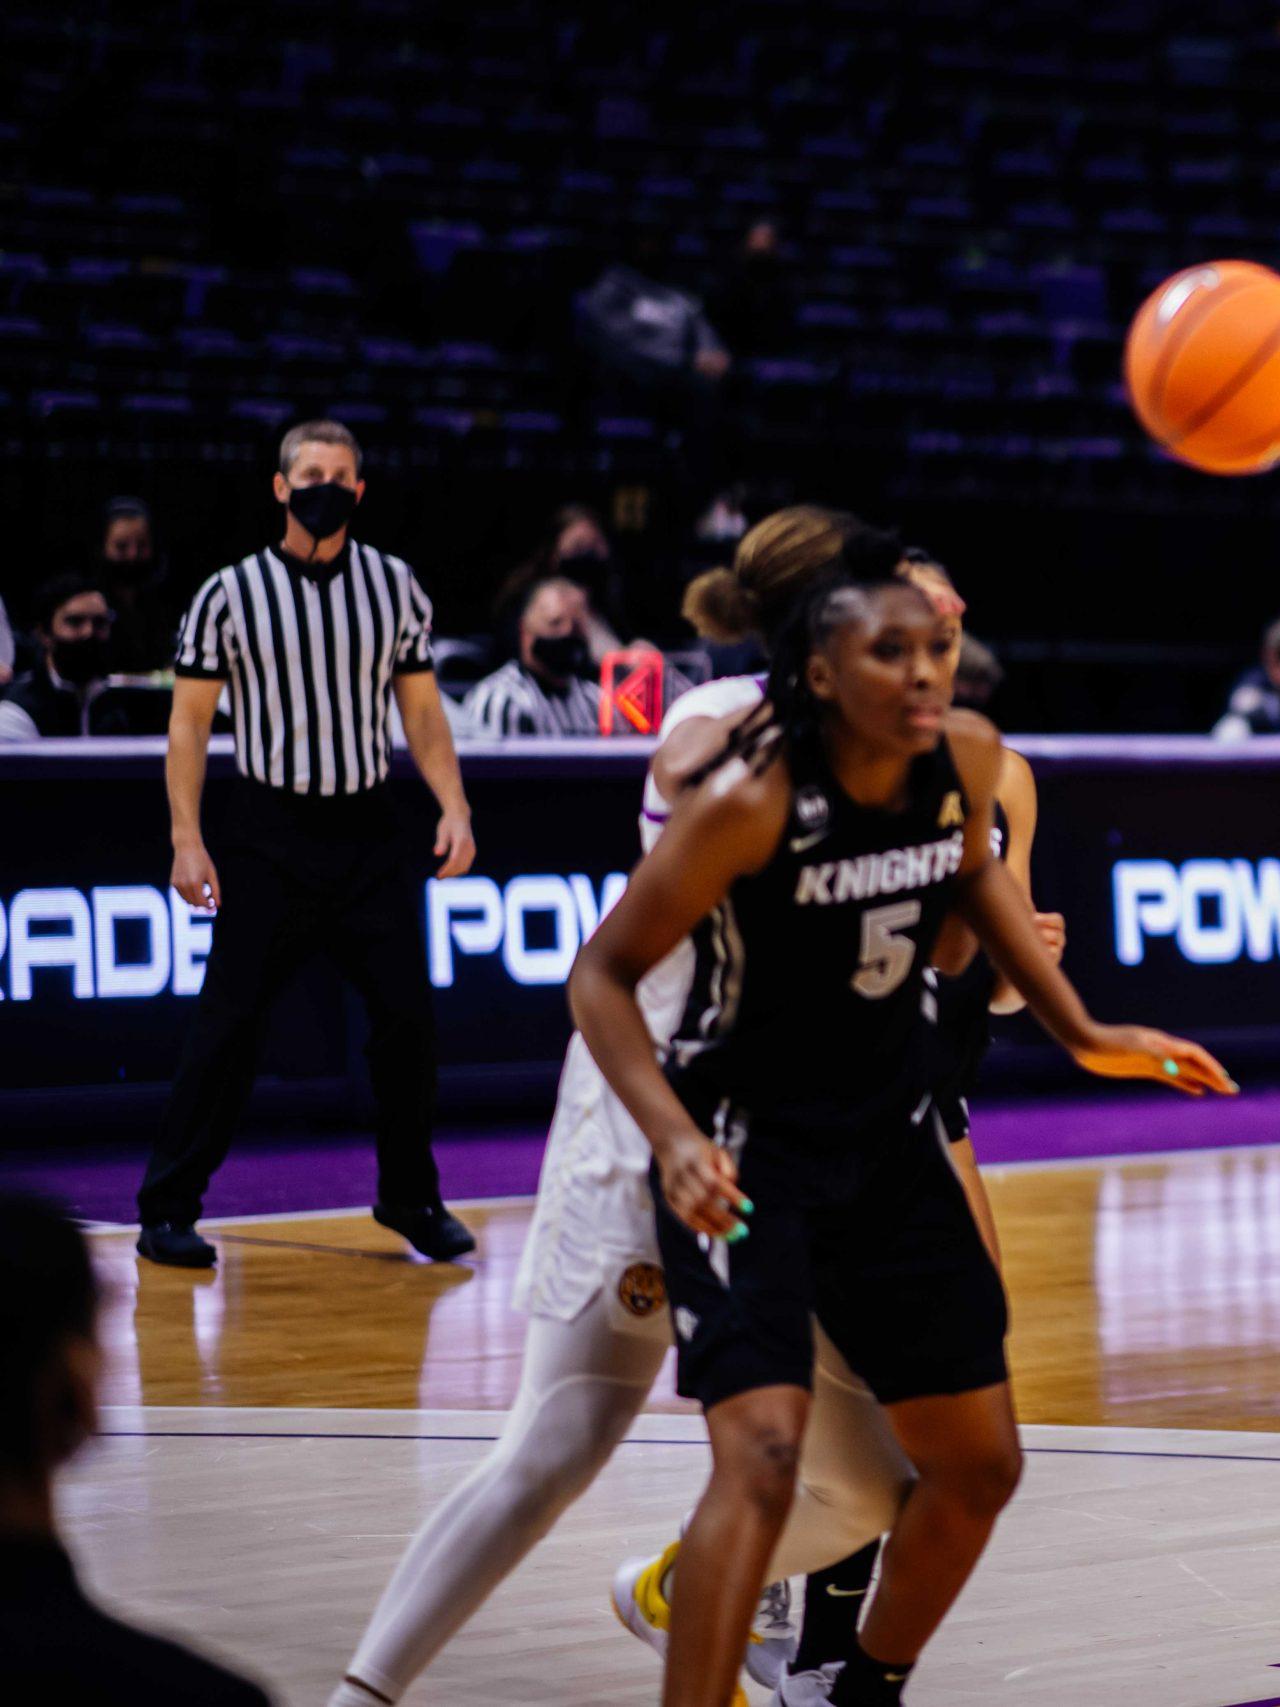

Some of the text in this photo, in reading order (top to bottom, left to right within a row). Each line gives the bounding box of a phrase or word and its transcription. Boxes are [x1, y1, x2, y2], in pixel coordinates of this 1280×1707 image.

[794, 830, 964, 904] KNIGHTS
[0, 885, 217, 1000] ADE
[851, 900, 921, 1000] 5
